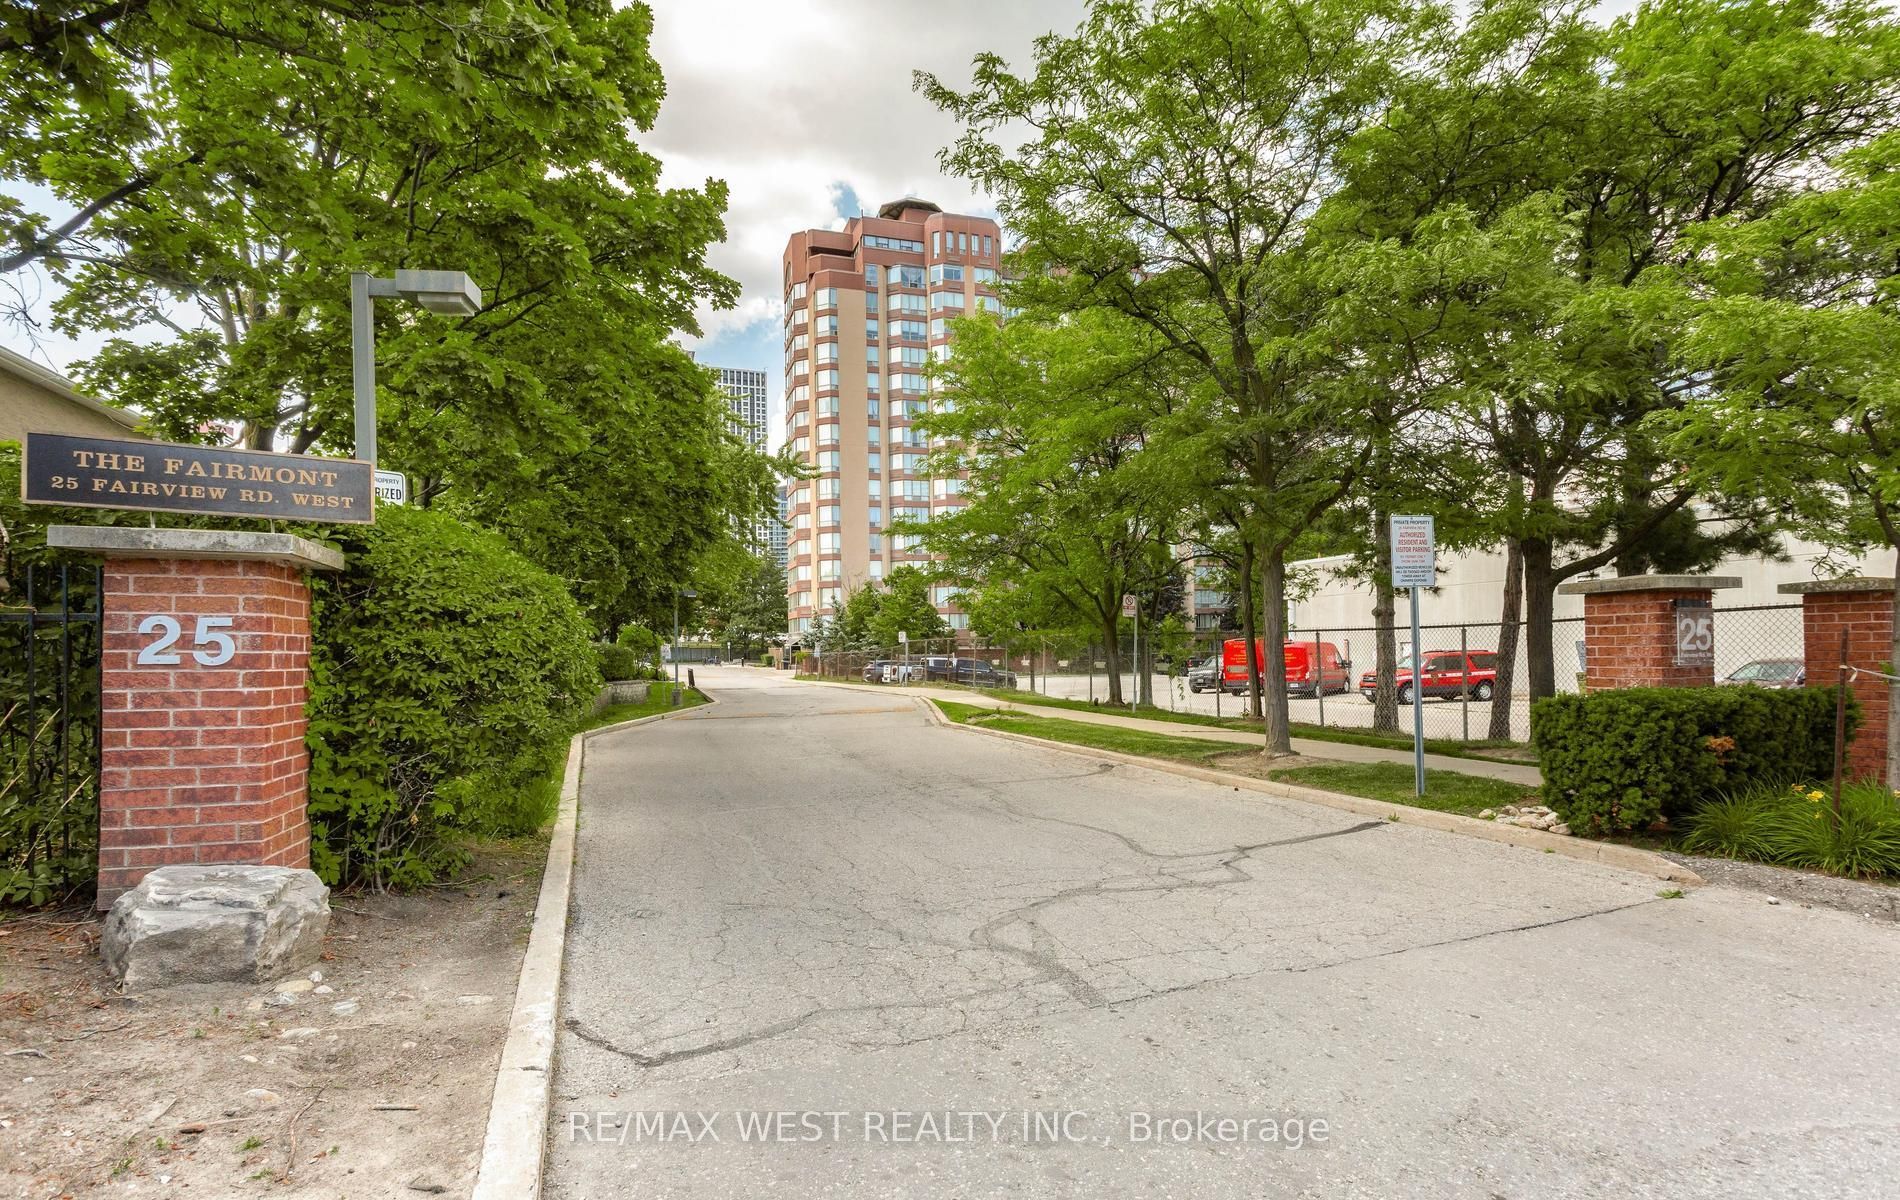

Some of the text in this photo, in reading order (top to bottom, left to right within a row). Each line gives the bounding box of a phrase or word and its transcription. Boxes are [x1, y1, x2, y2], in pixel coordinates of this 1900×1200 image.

[73, 450, 338, 487] THE FAIRMONT
[51, 475, 354, 509] 25 FAIRVIEW RD. WEST
[137, 615, 236, 666] 25
[1680, 618, 1712, 650] 25
